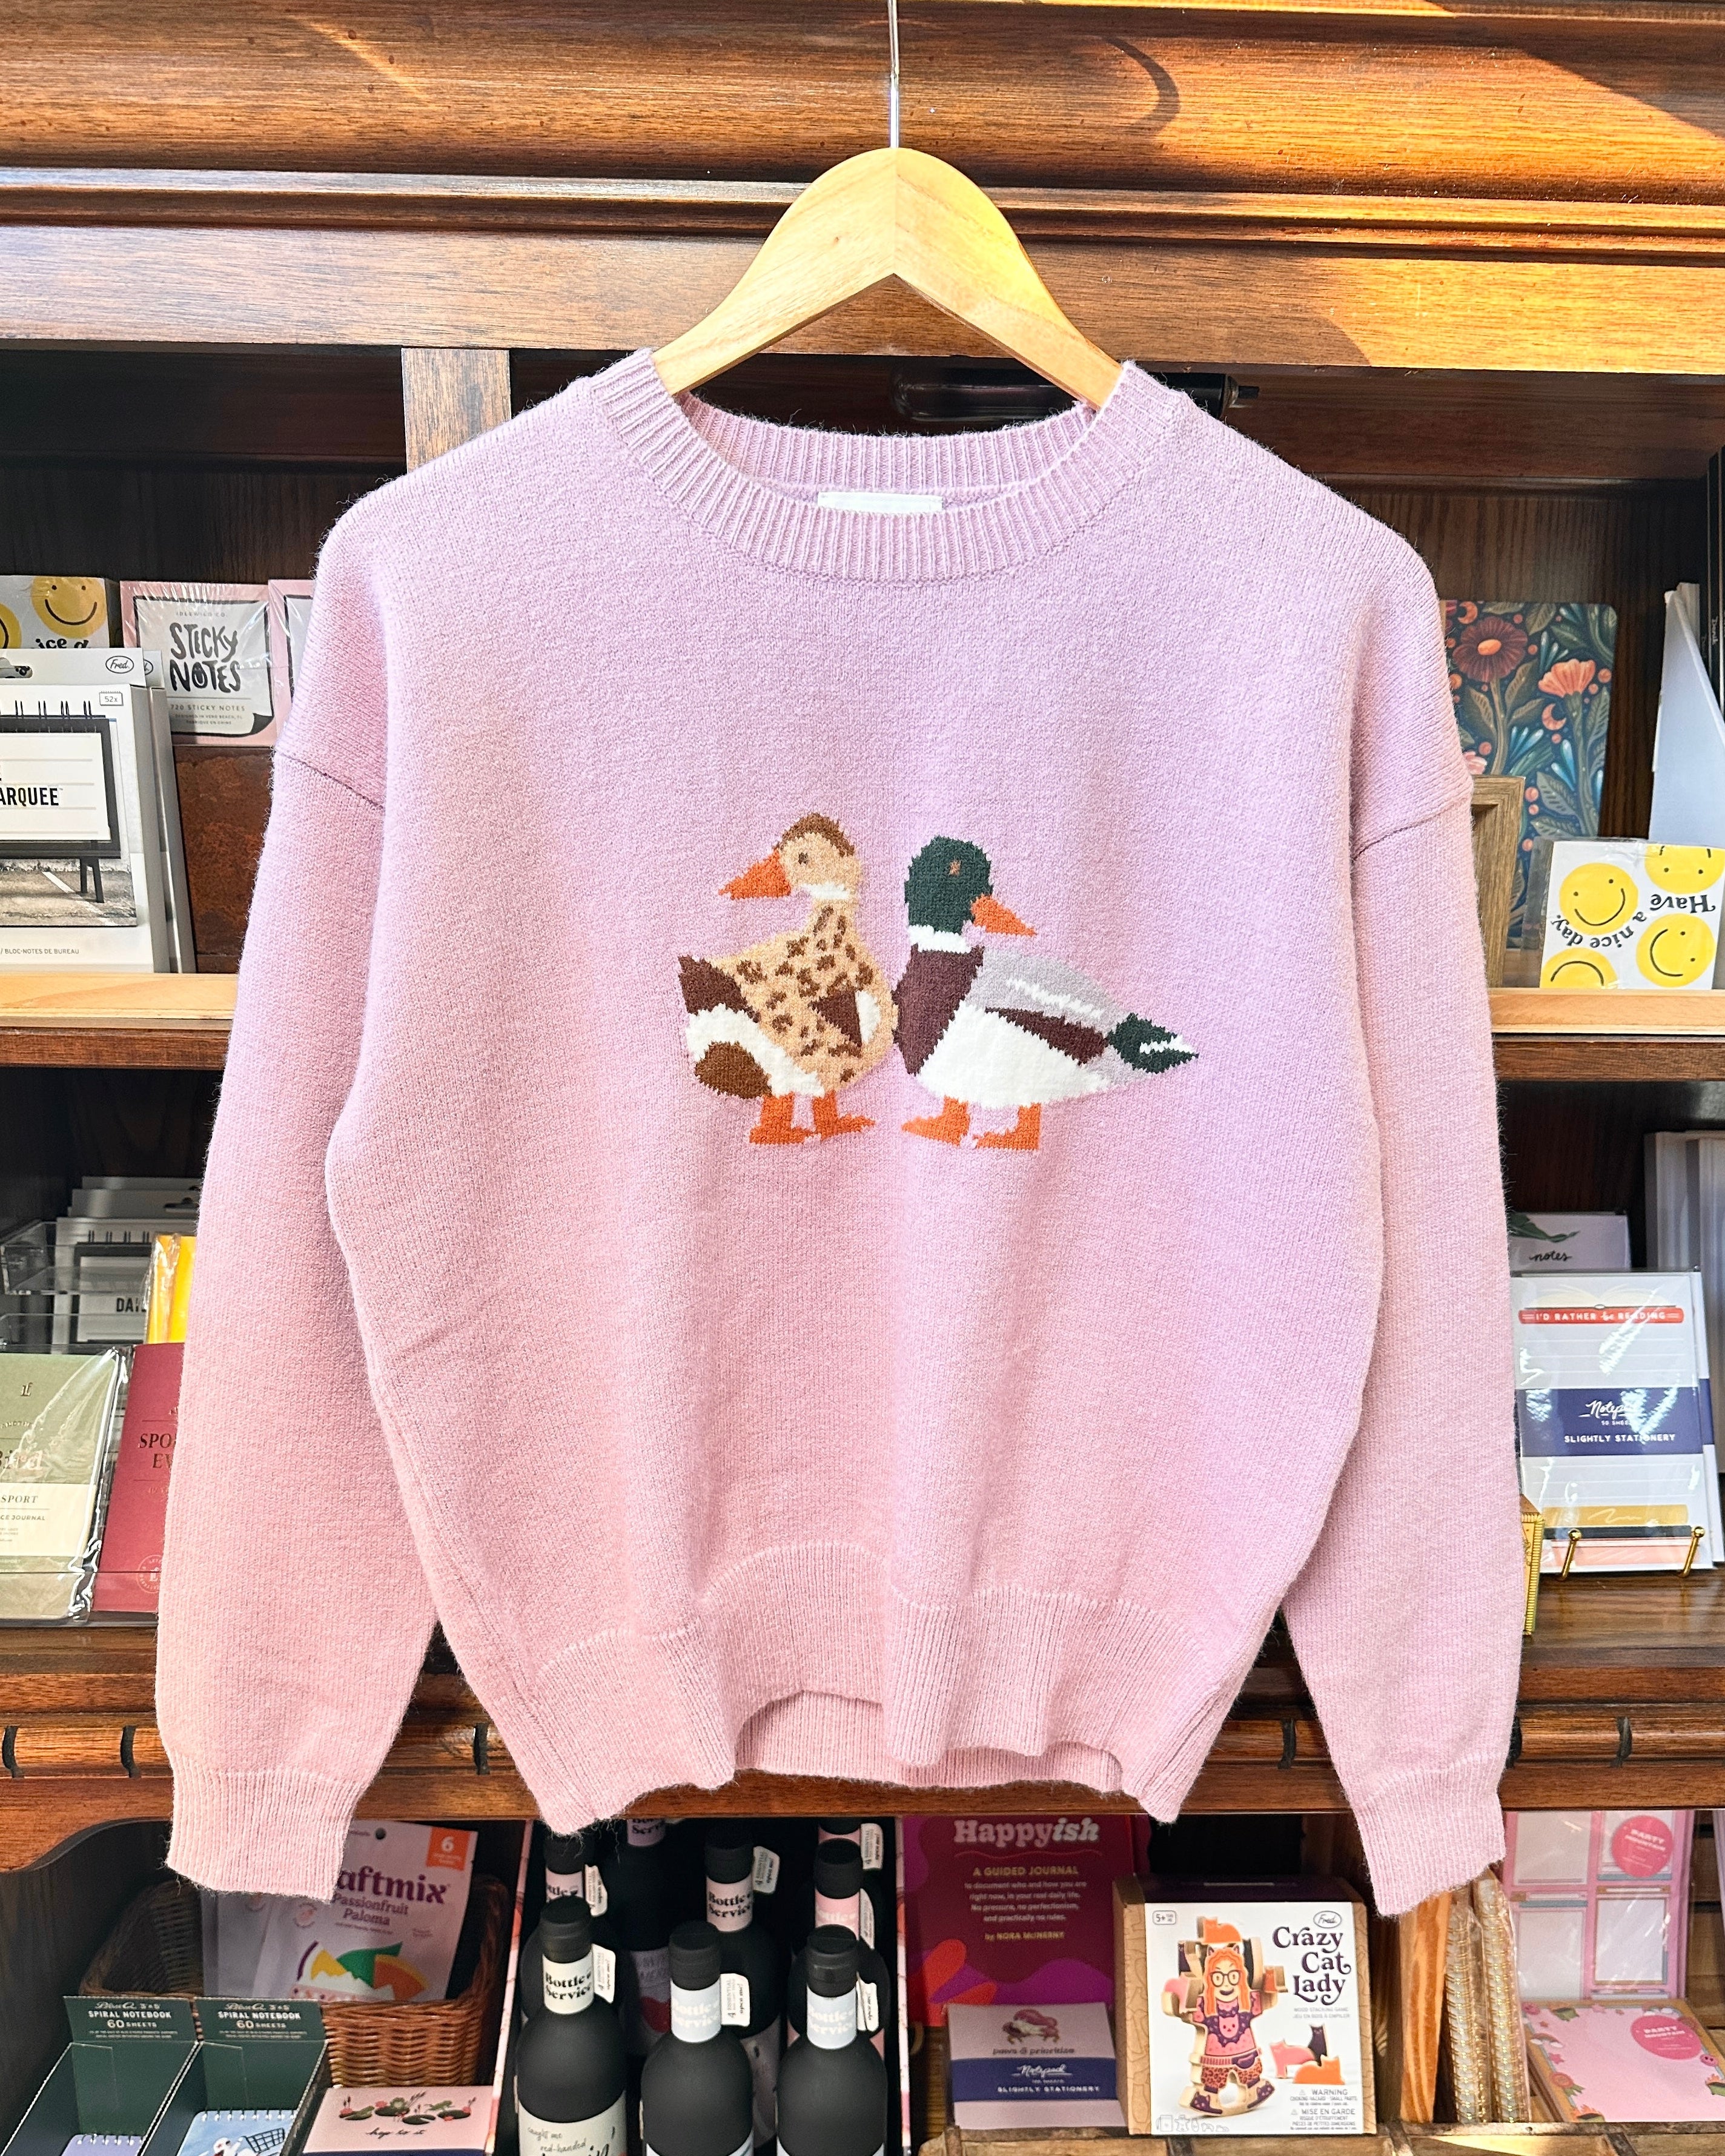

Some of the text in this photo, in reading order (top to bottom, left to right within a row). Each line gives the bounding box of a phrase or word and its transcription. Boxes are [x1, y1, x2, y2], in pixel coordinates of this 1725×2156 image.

[170, 623, 238, 663] STICKY
[170, 660, 241, 693] NOTES
[1551, 894, 1716, 948] Have a nice day.
[1529, 1249, 1572, 1262] notes
[1555, 1312, 1597, 1321] RATHER
[1618, 1312, 1666, 1320] REDING
[1564, 1434, 1611, 1443] SLIGHTLY
[954, 1817, 1099, 1847] Happyish
[441, 1836, 454, 1852] 6
[973, 1866, 1079, 1876] A GUIDED JOURNAL
[333, 1893, 408, 1915] Passionfruit
[343, 1908, 390, 1925] Paloma
[1273, 1926, 1343, 1954] Crazy
[1302, 1951, 1352, 1975] Cat
[546, 1972, 585, 1987] Bottle
[1293, 1973, 1346, 2006] Lady
[107, 2019, 124, 2028] 60
[236, 2020, 254, 2029] 60
